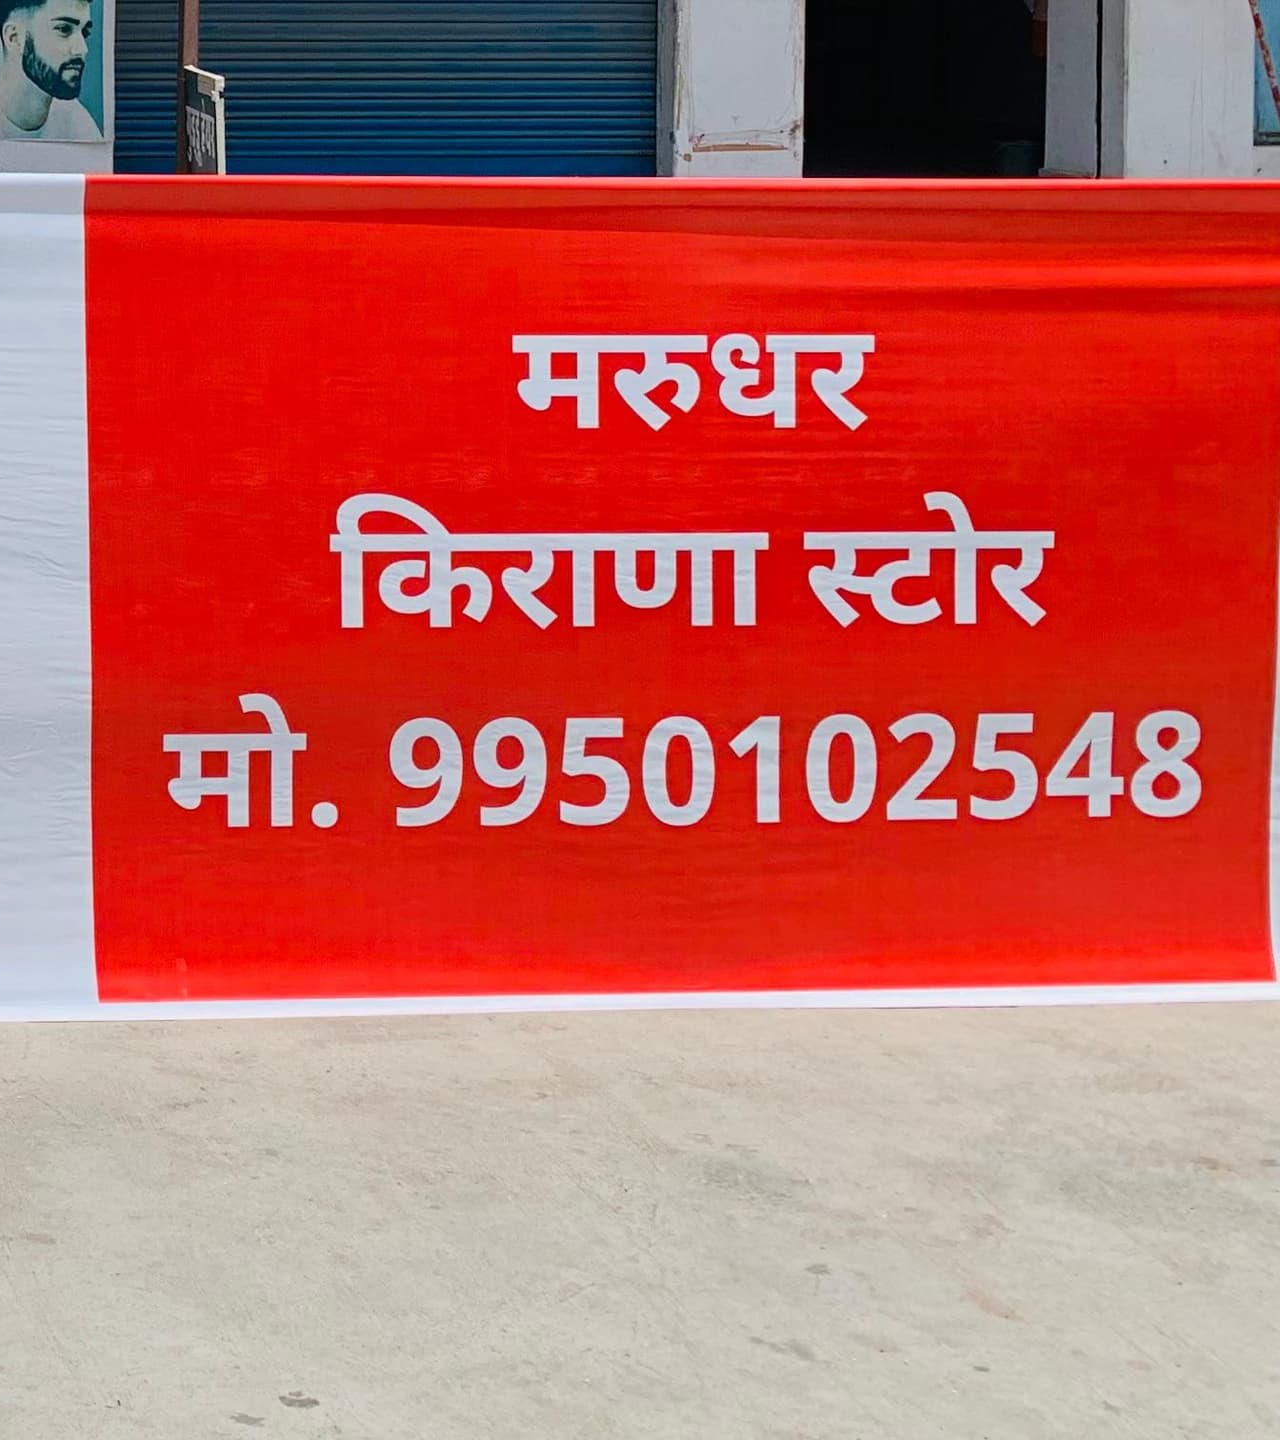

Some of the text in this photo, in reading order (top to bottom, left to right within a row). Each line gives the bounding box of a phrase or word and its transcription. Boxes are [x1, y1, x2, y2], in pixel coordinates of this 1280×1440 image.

[512, 332, 876, 431] मरुधर
[329, 491, 1056, 630] किराणा स्टोर
[161, 693, 1204, 830] मो. 9950102548
